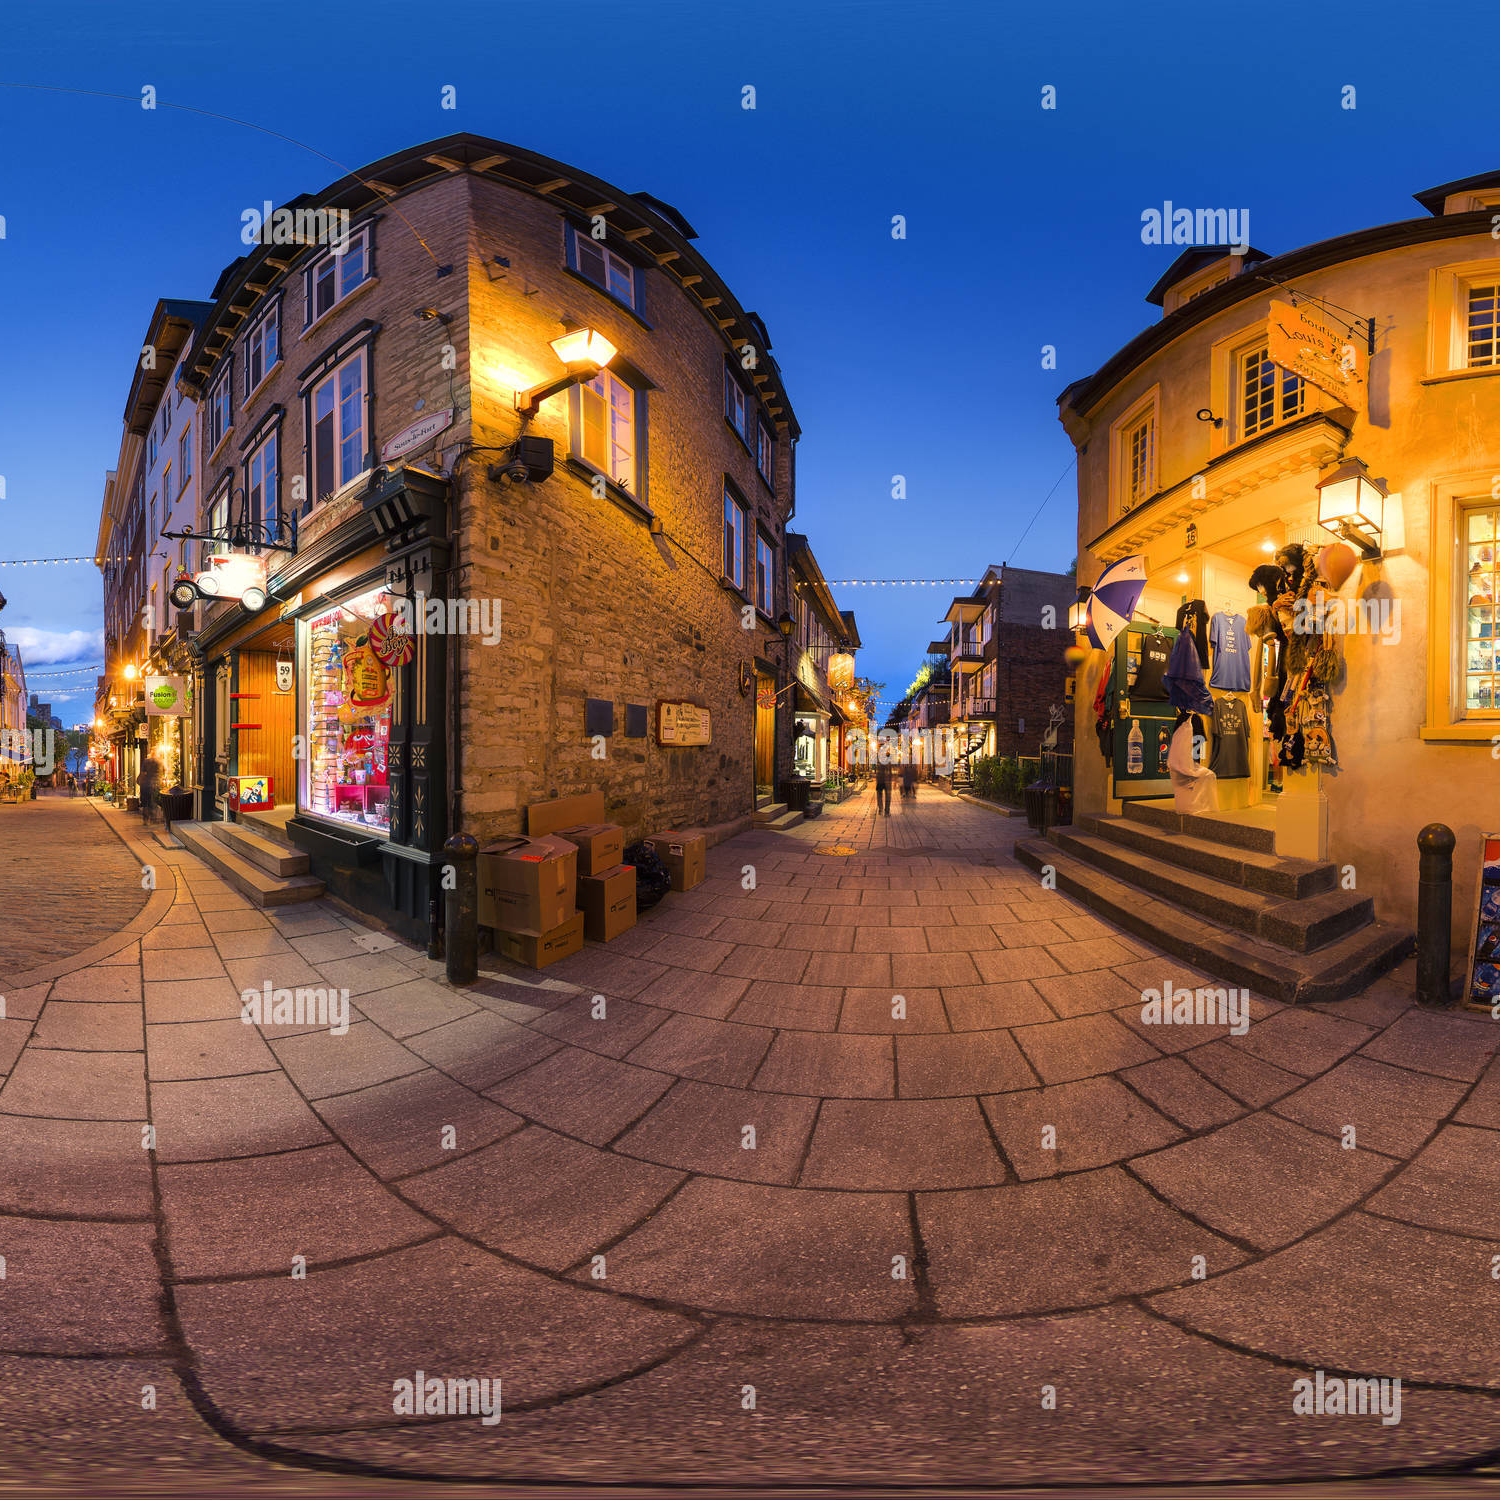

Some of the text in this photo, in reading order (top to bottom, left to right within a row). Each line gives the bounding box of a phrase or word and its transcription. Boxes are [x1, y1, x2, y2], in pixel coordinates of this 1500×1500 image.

[1277, 323, 1325, 349] Louis
[1300, 313, 1349, 347] boutique
[394, 423, 436, 451] Sous-le-Fort
[1187, 531, 1196, 544] 16
[280, 666, 290, 675] 59
